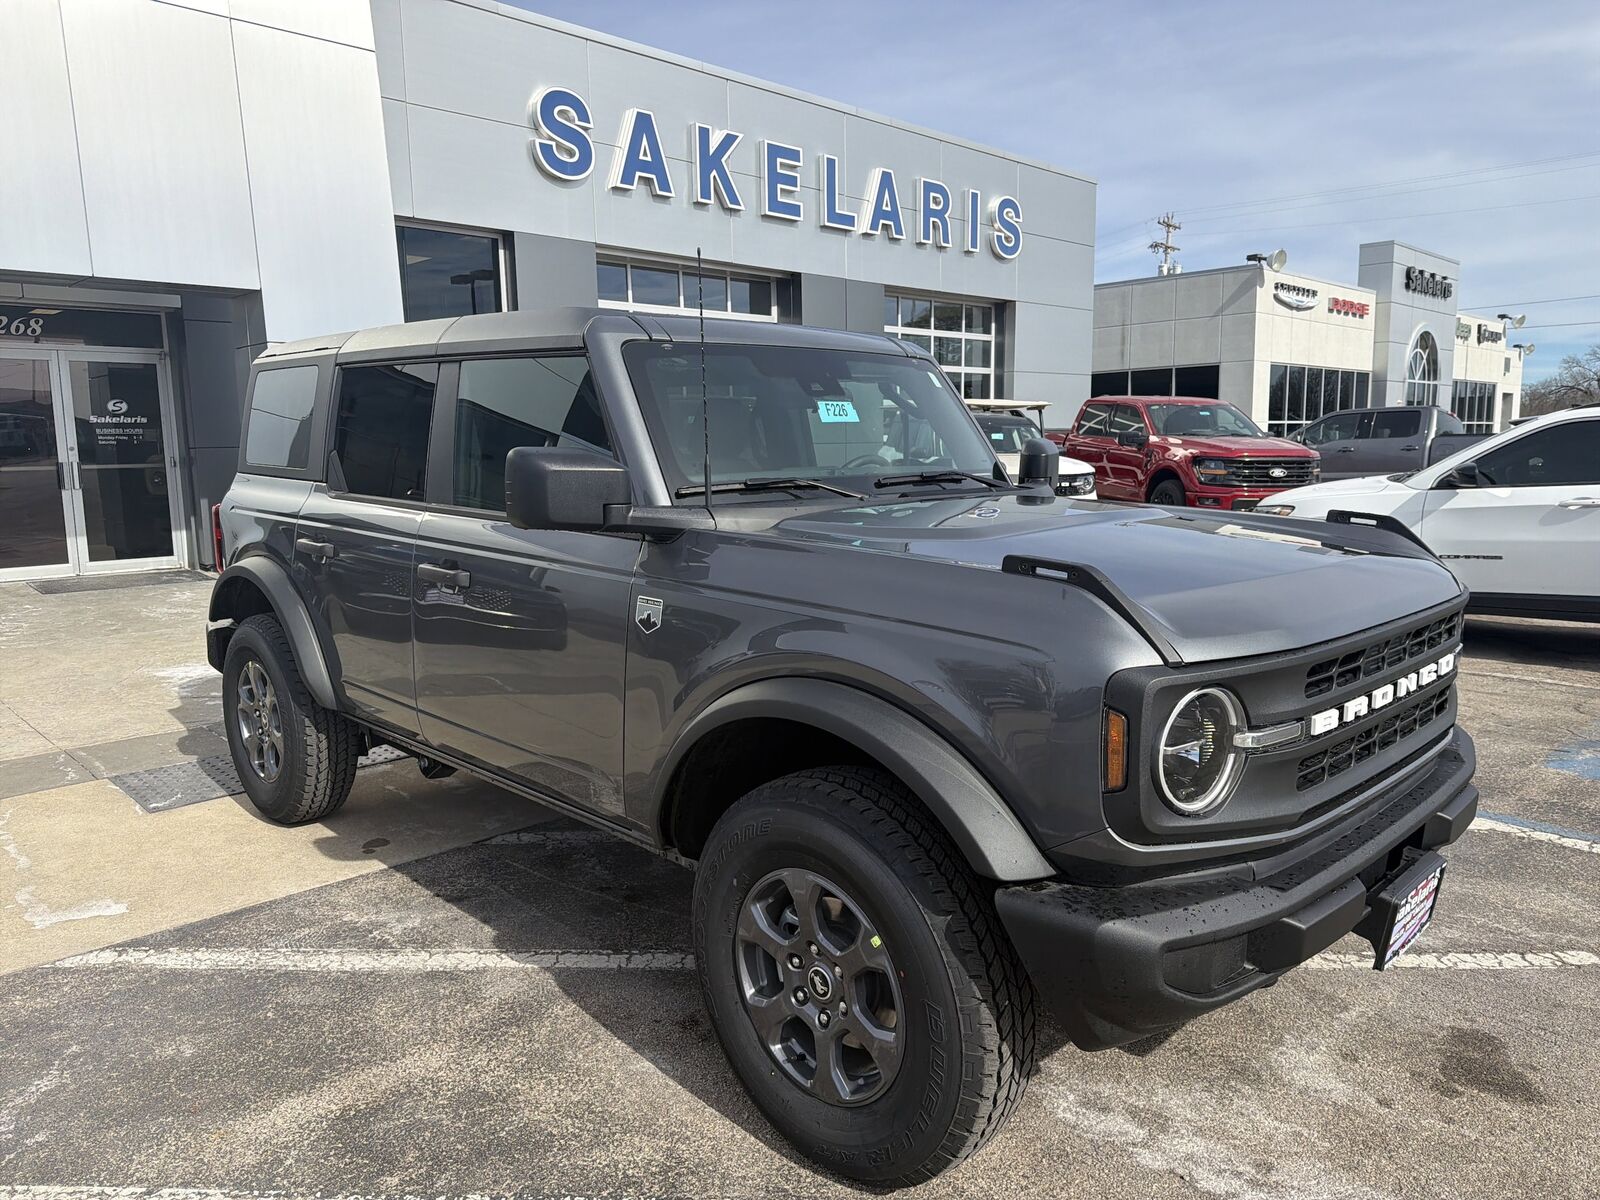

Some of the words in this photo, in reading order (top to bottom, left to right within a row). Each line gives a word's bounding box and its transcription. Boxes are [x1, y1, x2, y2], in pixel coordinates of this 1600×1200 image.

[530, 86, 1024, 260] SAKELARIS
[0, 315, 44, 336] 268
[89, 415, 147, 423] Sakelaris
[824, 402, 848, 416] F226
[1310, 653, 1455, 736] BRONCO
